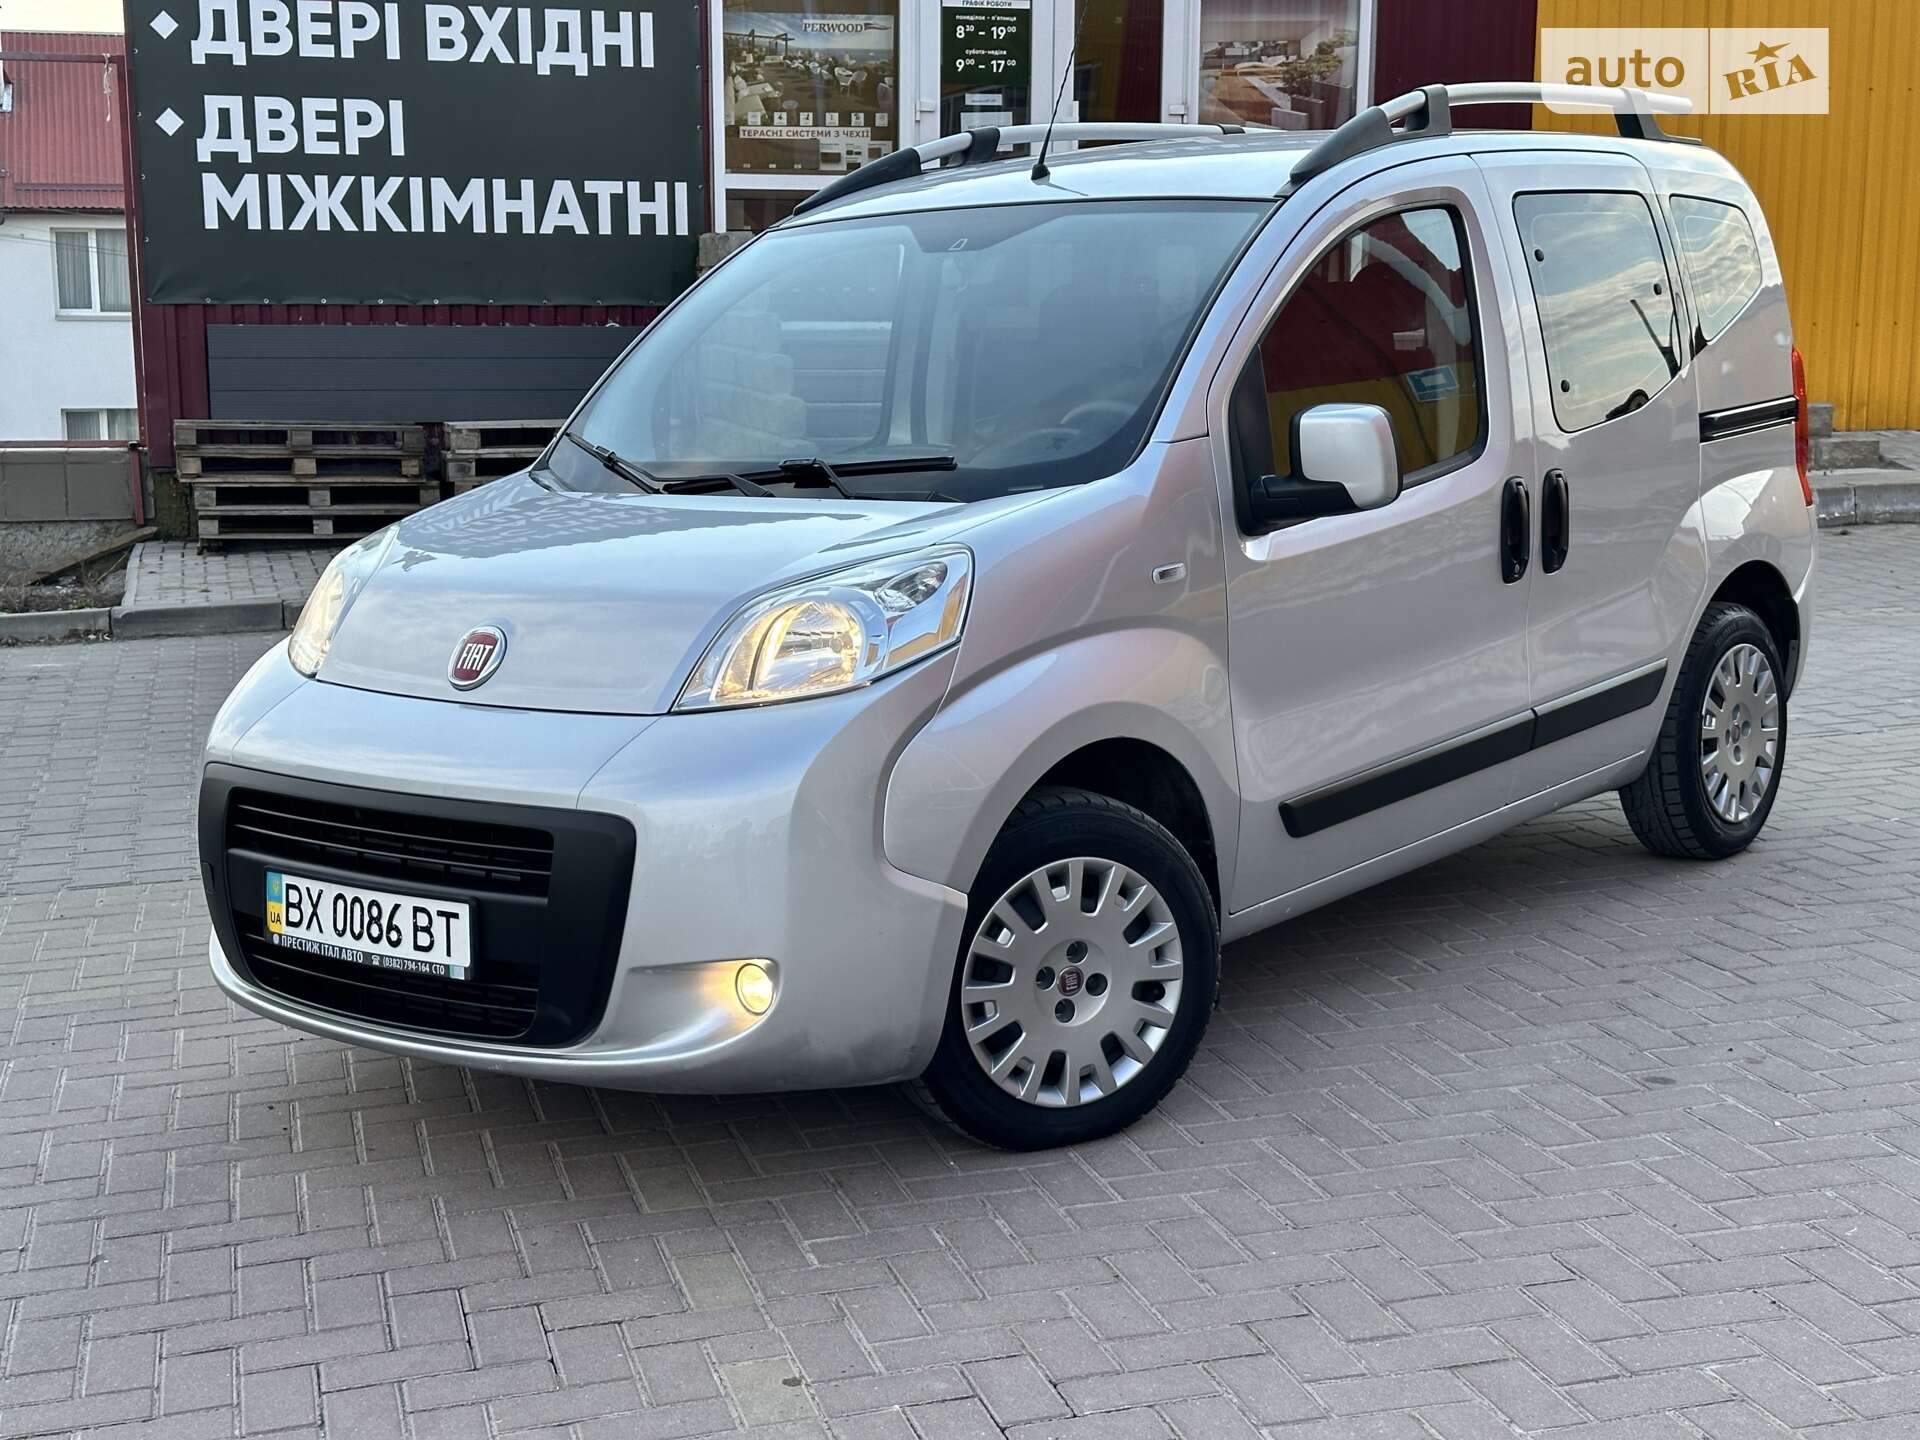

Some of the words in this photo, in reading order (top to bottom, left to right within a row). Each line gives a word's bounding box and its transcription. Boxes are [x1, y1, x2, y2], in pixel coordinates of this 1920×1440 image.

[191, 0, 401, 66] ДВЕРІ
[425, 4, 655, 77] ВХІДНІ
[802, 22, 864, 33] PERWOOD
[196, 94, 406, 164] ДВЕРІ
[741, 129, 784, 138] ТЕРАСНІ
[785, 129, 832, 138] СИСТЕМИ
[201, 172, 690, 237] МІЖКІМНАТНІ
[456, 643, 494, 671] FIAT
[270, 911, 282, 925] UA
[332, 893, 402, 948] 0086
[281, 935, 320, 954] ПРЕСТИЖ
[341, 950, 364, 963] АВТО
